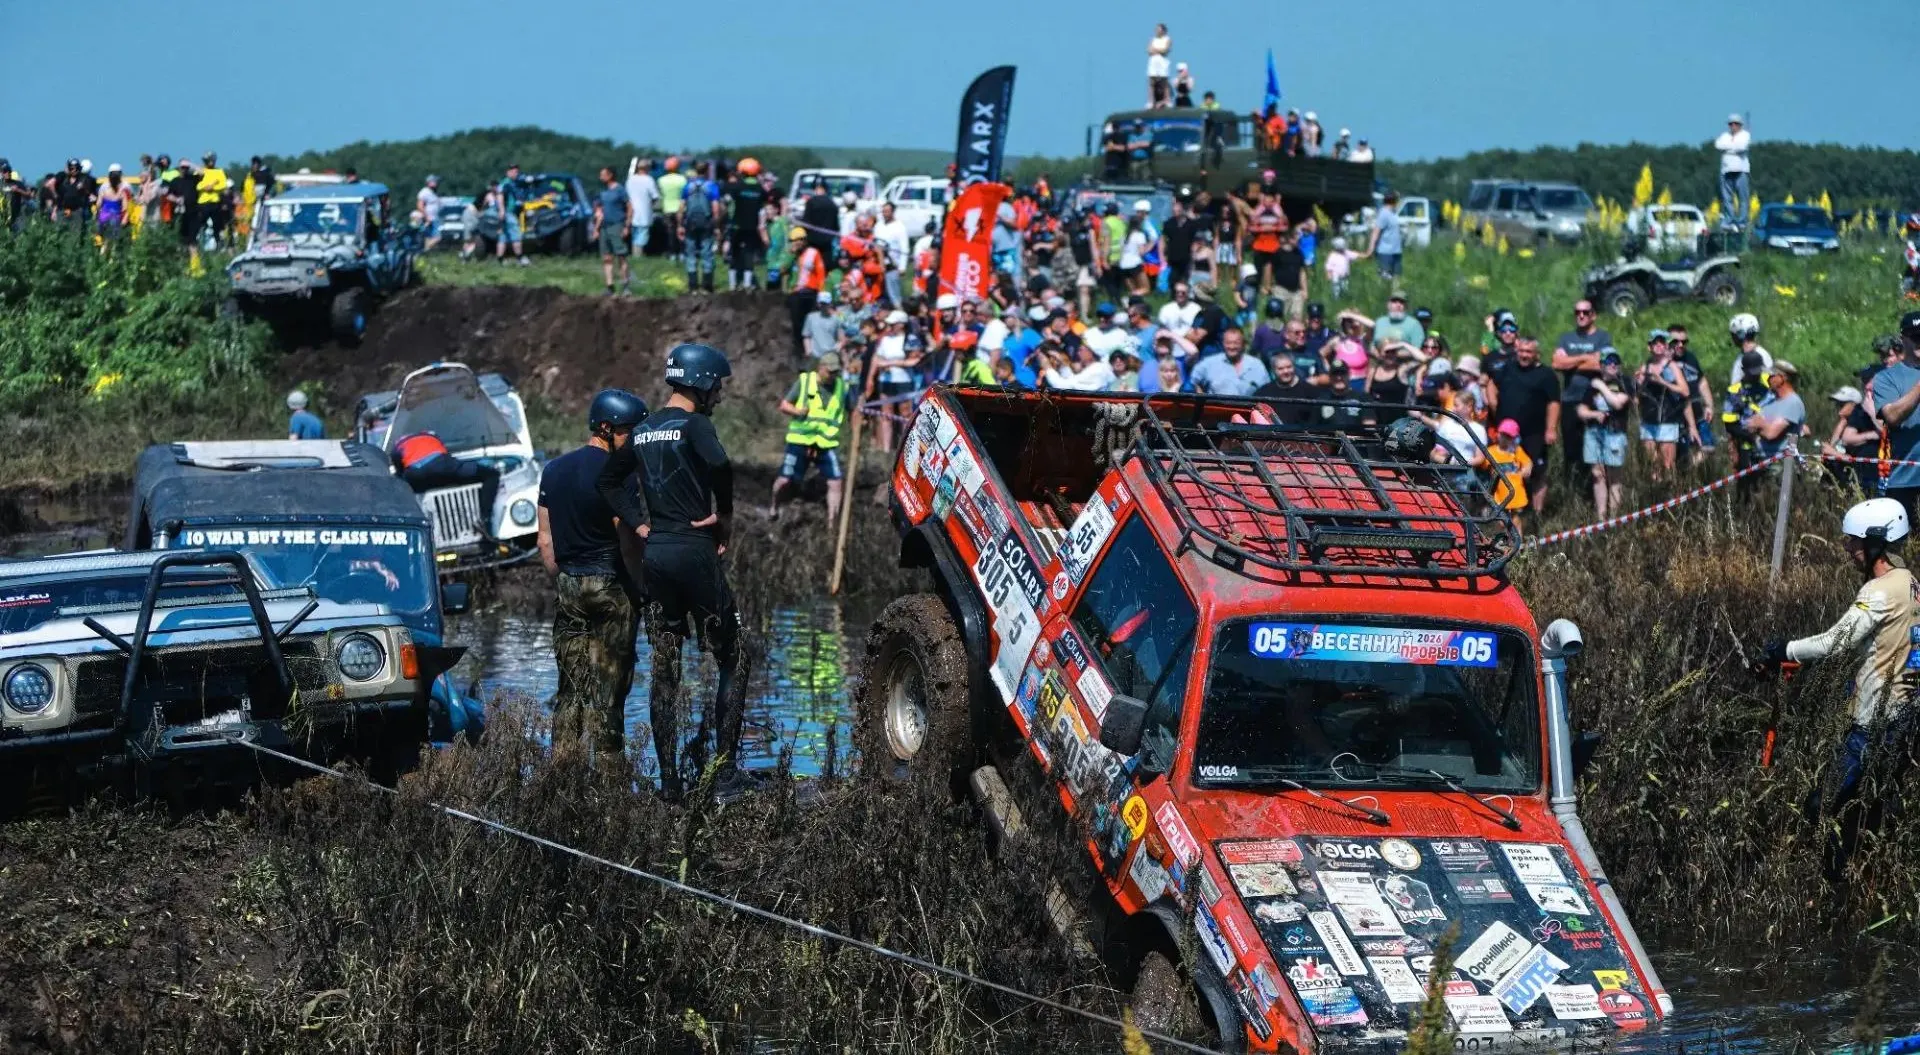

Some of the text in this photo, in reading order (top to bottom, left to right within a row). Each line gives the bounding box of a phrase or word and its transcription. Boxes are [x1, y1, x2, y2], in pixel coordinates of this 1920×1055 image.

[899, 489, 917, 517] WINCH
[206, 531, 245, 545] WAR
[247, 531, 280, 544] BUT
[282, 531, 316, 544] THE
[320, 531, 368, 545] CLASS
[369, 532, 408, 545] WAR
[1076, 521, 1097, 554] 55
[978, 541, 1015, 609] 305
[1003, 539, 1043, 603] SOLARX
[1255, 627, 1287, 653] 05
[1311, 631, 1414, 654] ВЕСЕННИЙ
[1417, 633, 1443, 643] 2026
[1462, 636, 1493, 662] 05
[1064, 633, 1087, 668] SOLARX
[1400, 644, 1459, 661] ПРОРЫВ
[1198, 765, 1238, 777] VOLGA
[1305, 842, 1382, 859] VOLGA
[1296, 979, 1341, 989] SPORT
